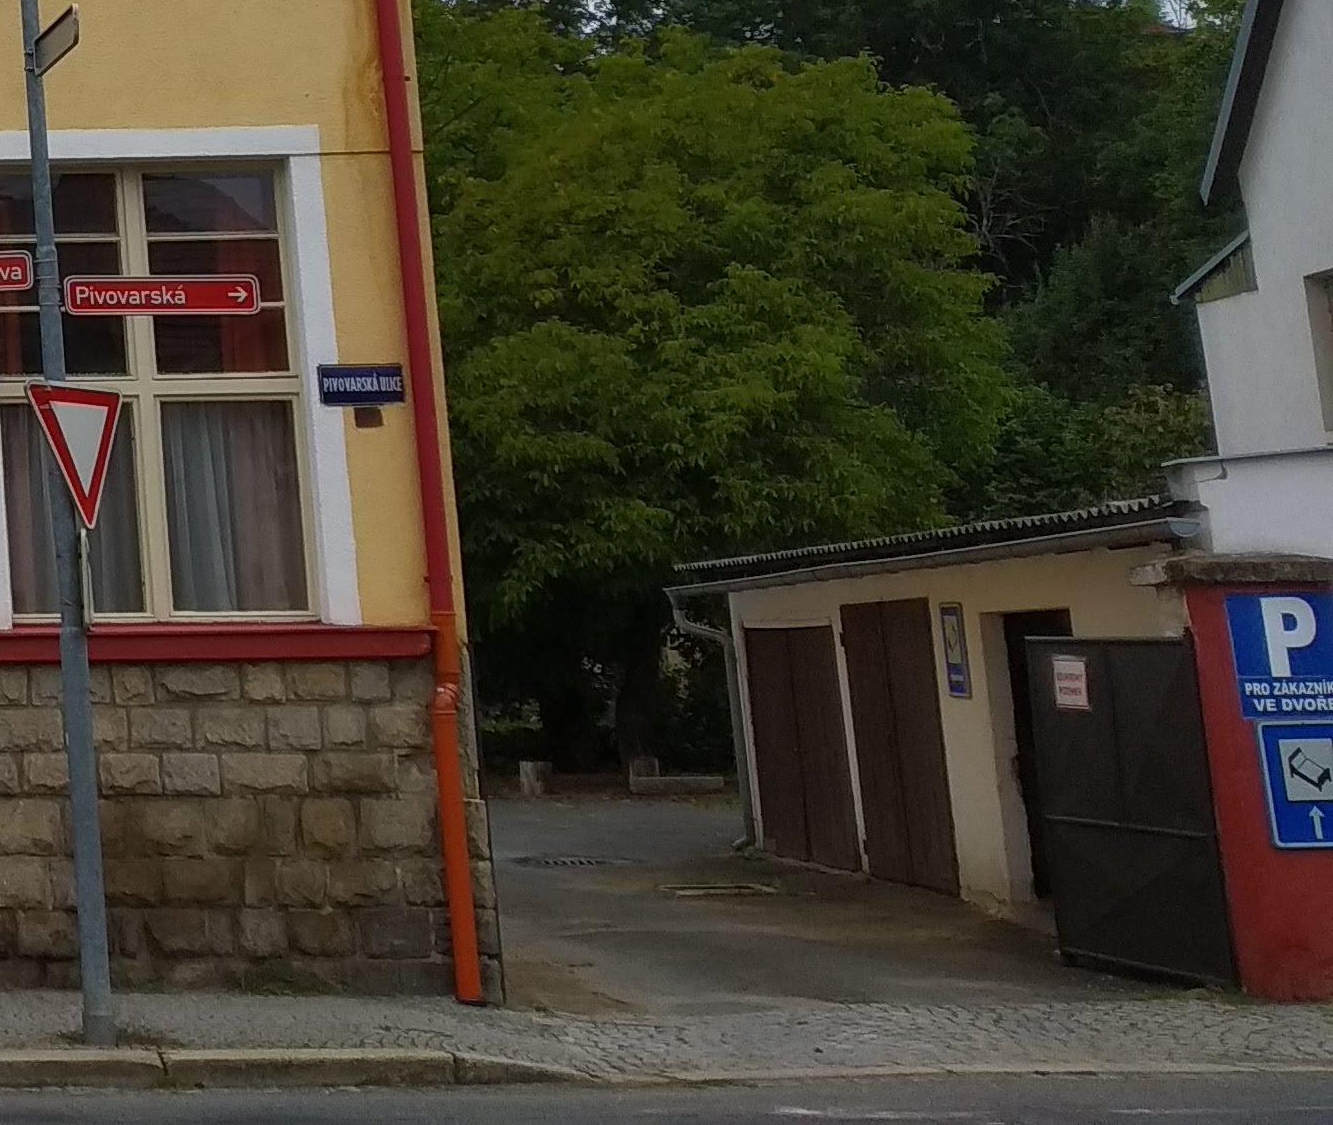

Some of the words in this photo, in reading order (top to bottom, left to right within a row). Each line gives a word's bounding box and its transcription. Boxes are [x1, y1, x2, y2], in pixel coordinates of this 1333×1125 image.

[75, 284, 187, 305] Pivovarská
[322, 372, 379, 393] PIVOVARSKÁ
[379, 376, 403, 392] ULICE
[1259, 596, 1317, 678] P
[1244, 682, 1269, 696] PRO
[1253, 698, 1278, 712] VE
